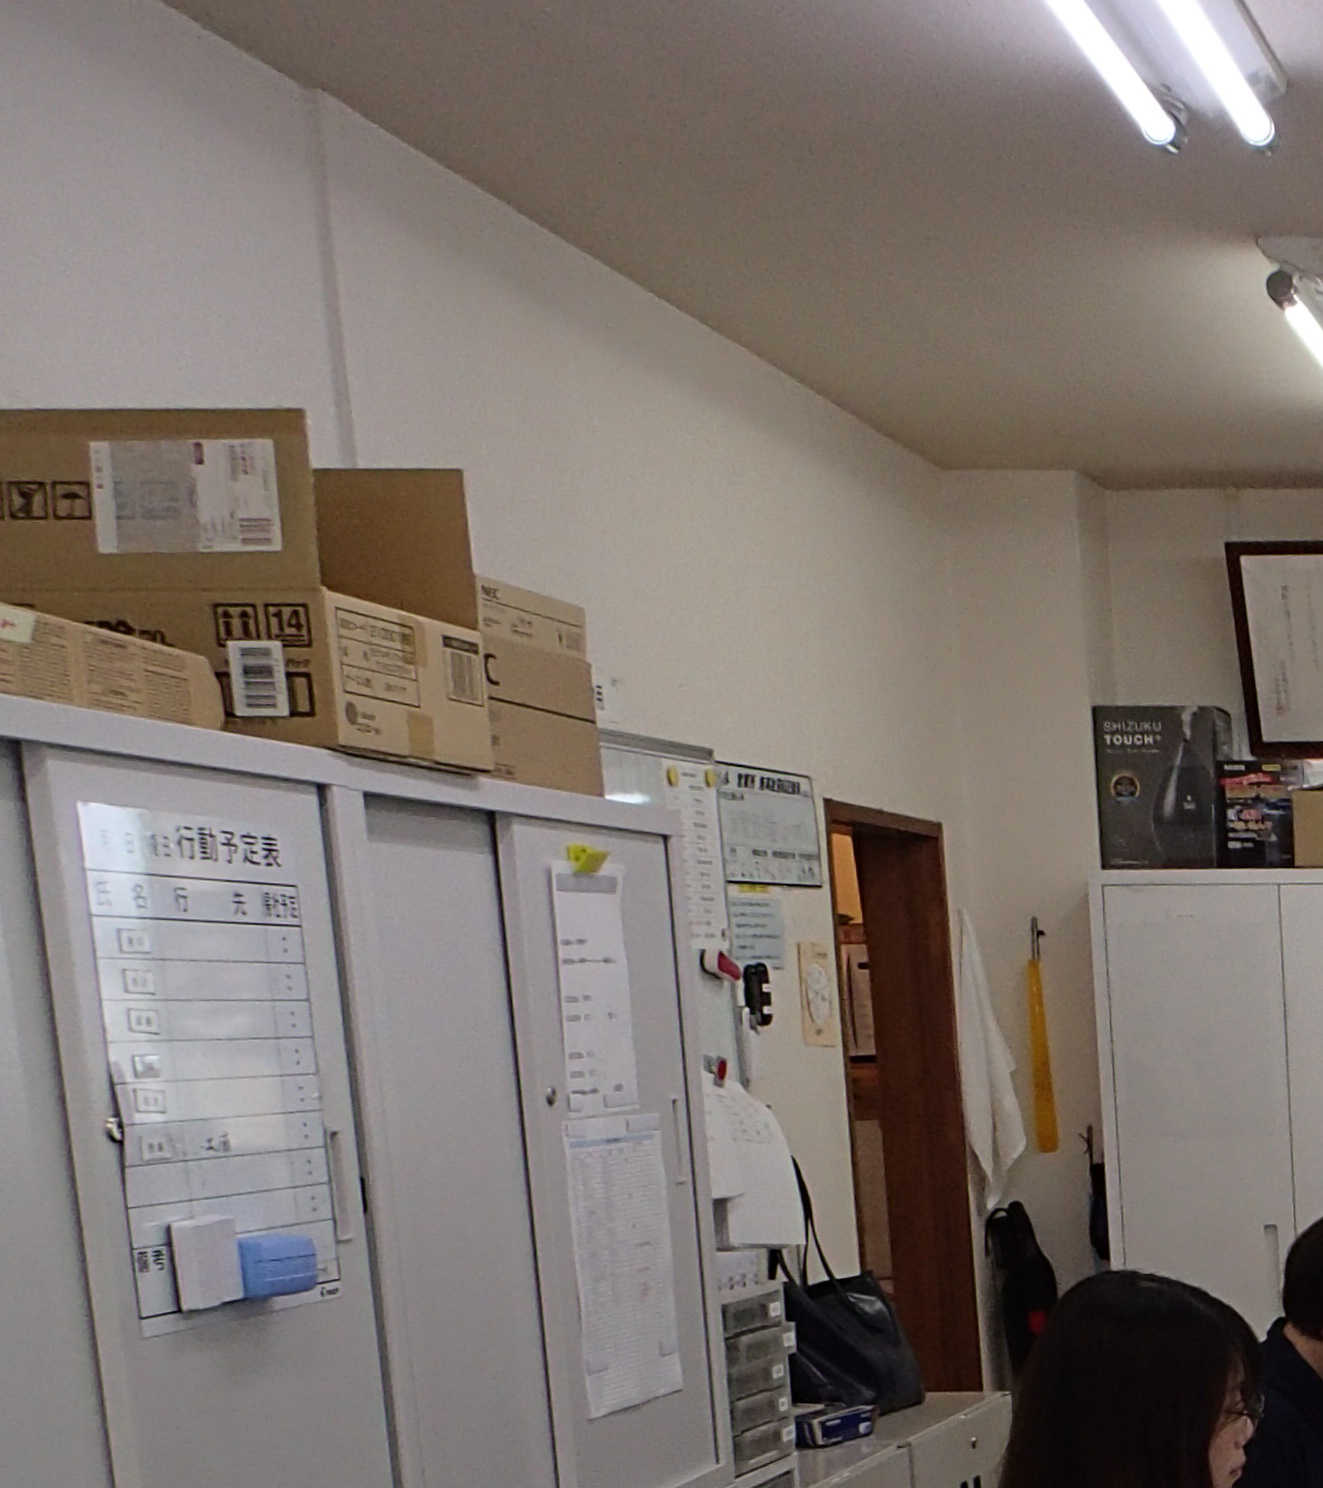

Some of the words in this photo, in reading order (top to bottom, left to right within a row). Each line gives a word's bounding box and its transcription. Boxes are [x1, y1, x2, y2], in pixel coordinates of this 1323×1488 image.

[271, 608, 304, 633] 14
[1103, 720, 1162, 732] SHIZUKU
[176, 826, 282, 868] 行動予定表
